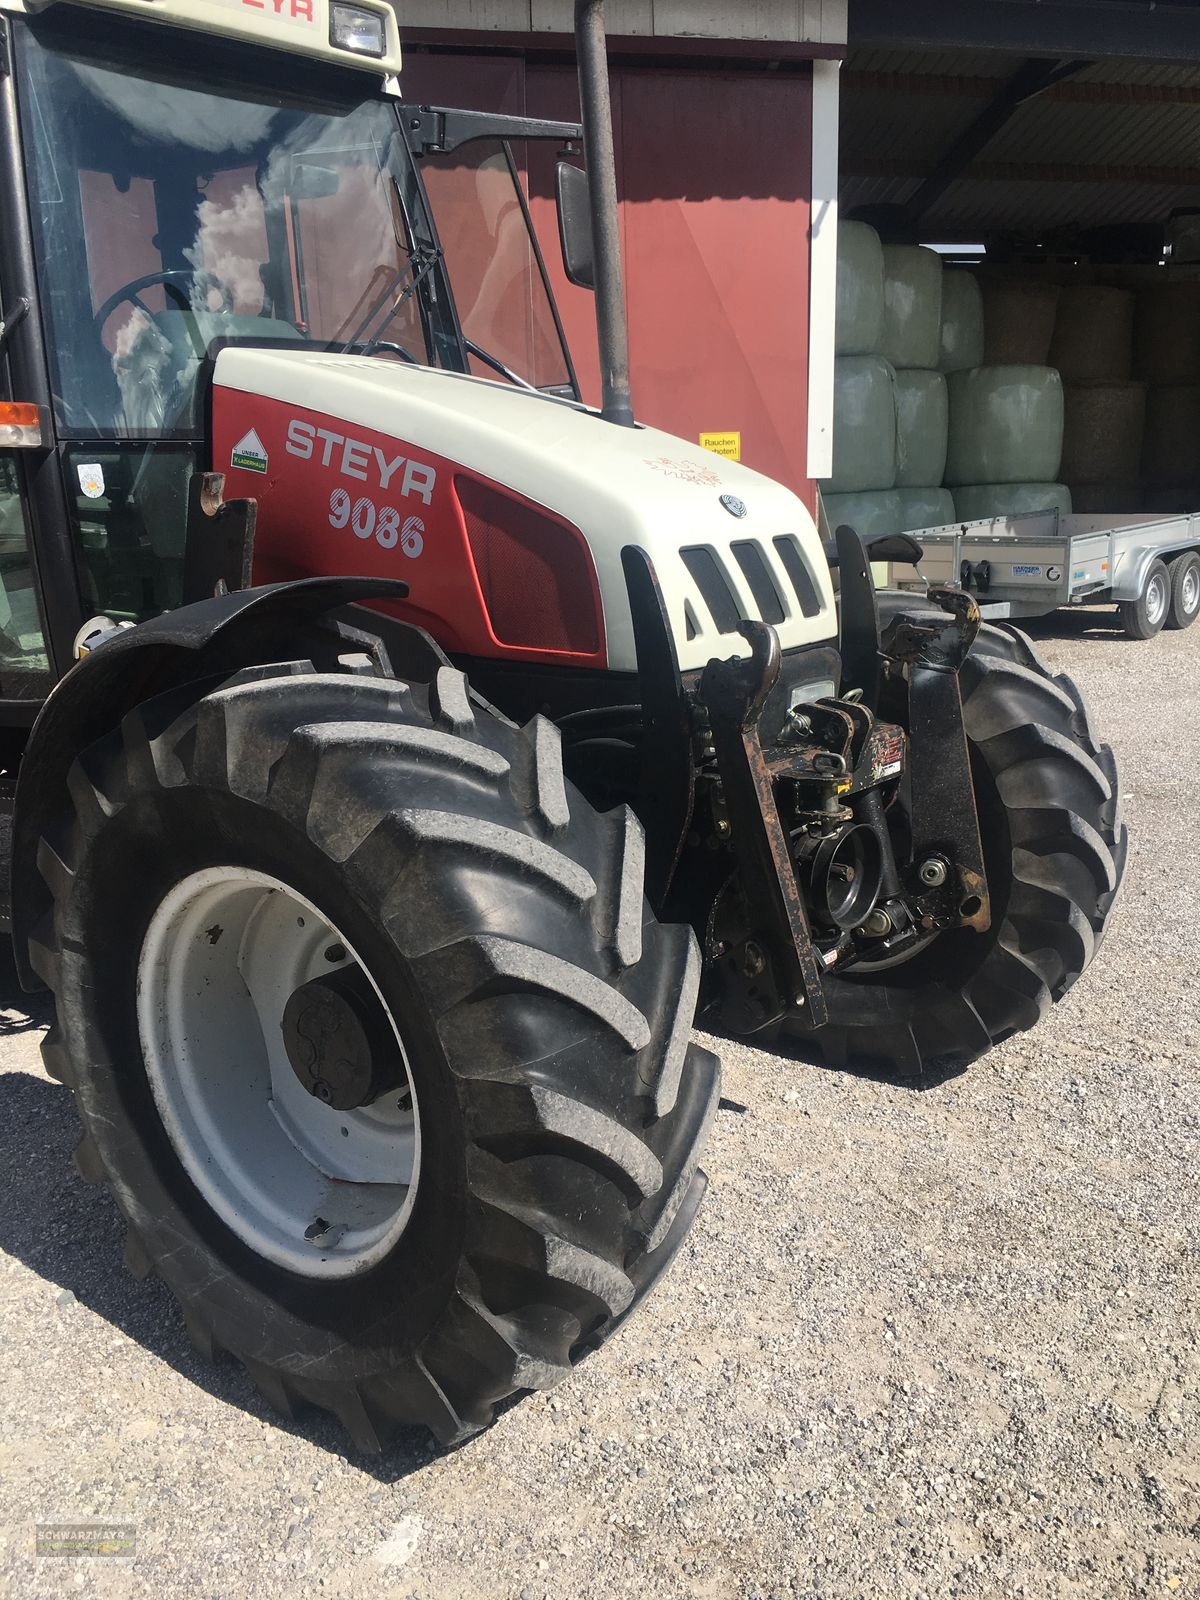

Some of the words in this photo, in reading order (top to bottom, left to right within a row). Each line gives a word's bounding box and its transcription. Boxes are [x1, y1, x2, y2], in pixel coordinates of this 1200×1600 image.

[285, 419, 437, 506] STEYR
[704, 439, 736, 447] Rauchen
[328, 488, 425, 559] 9086
